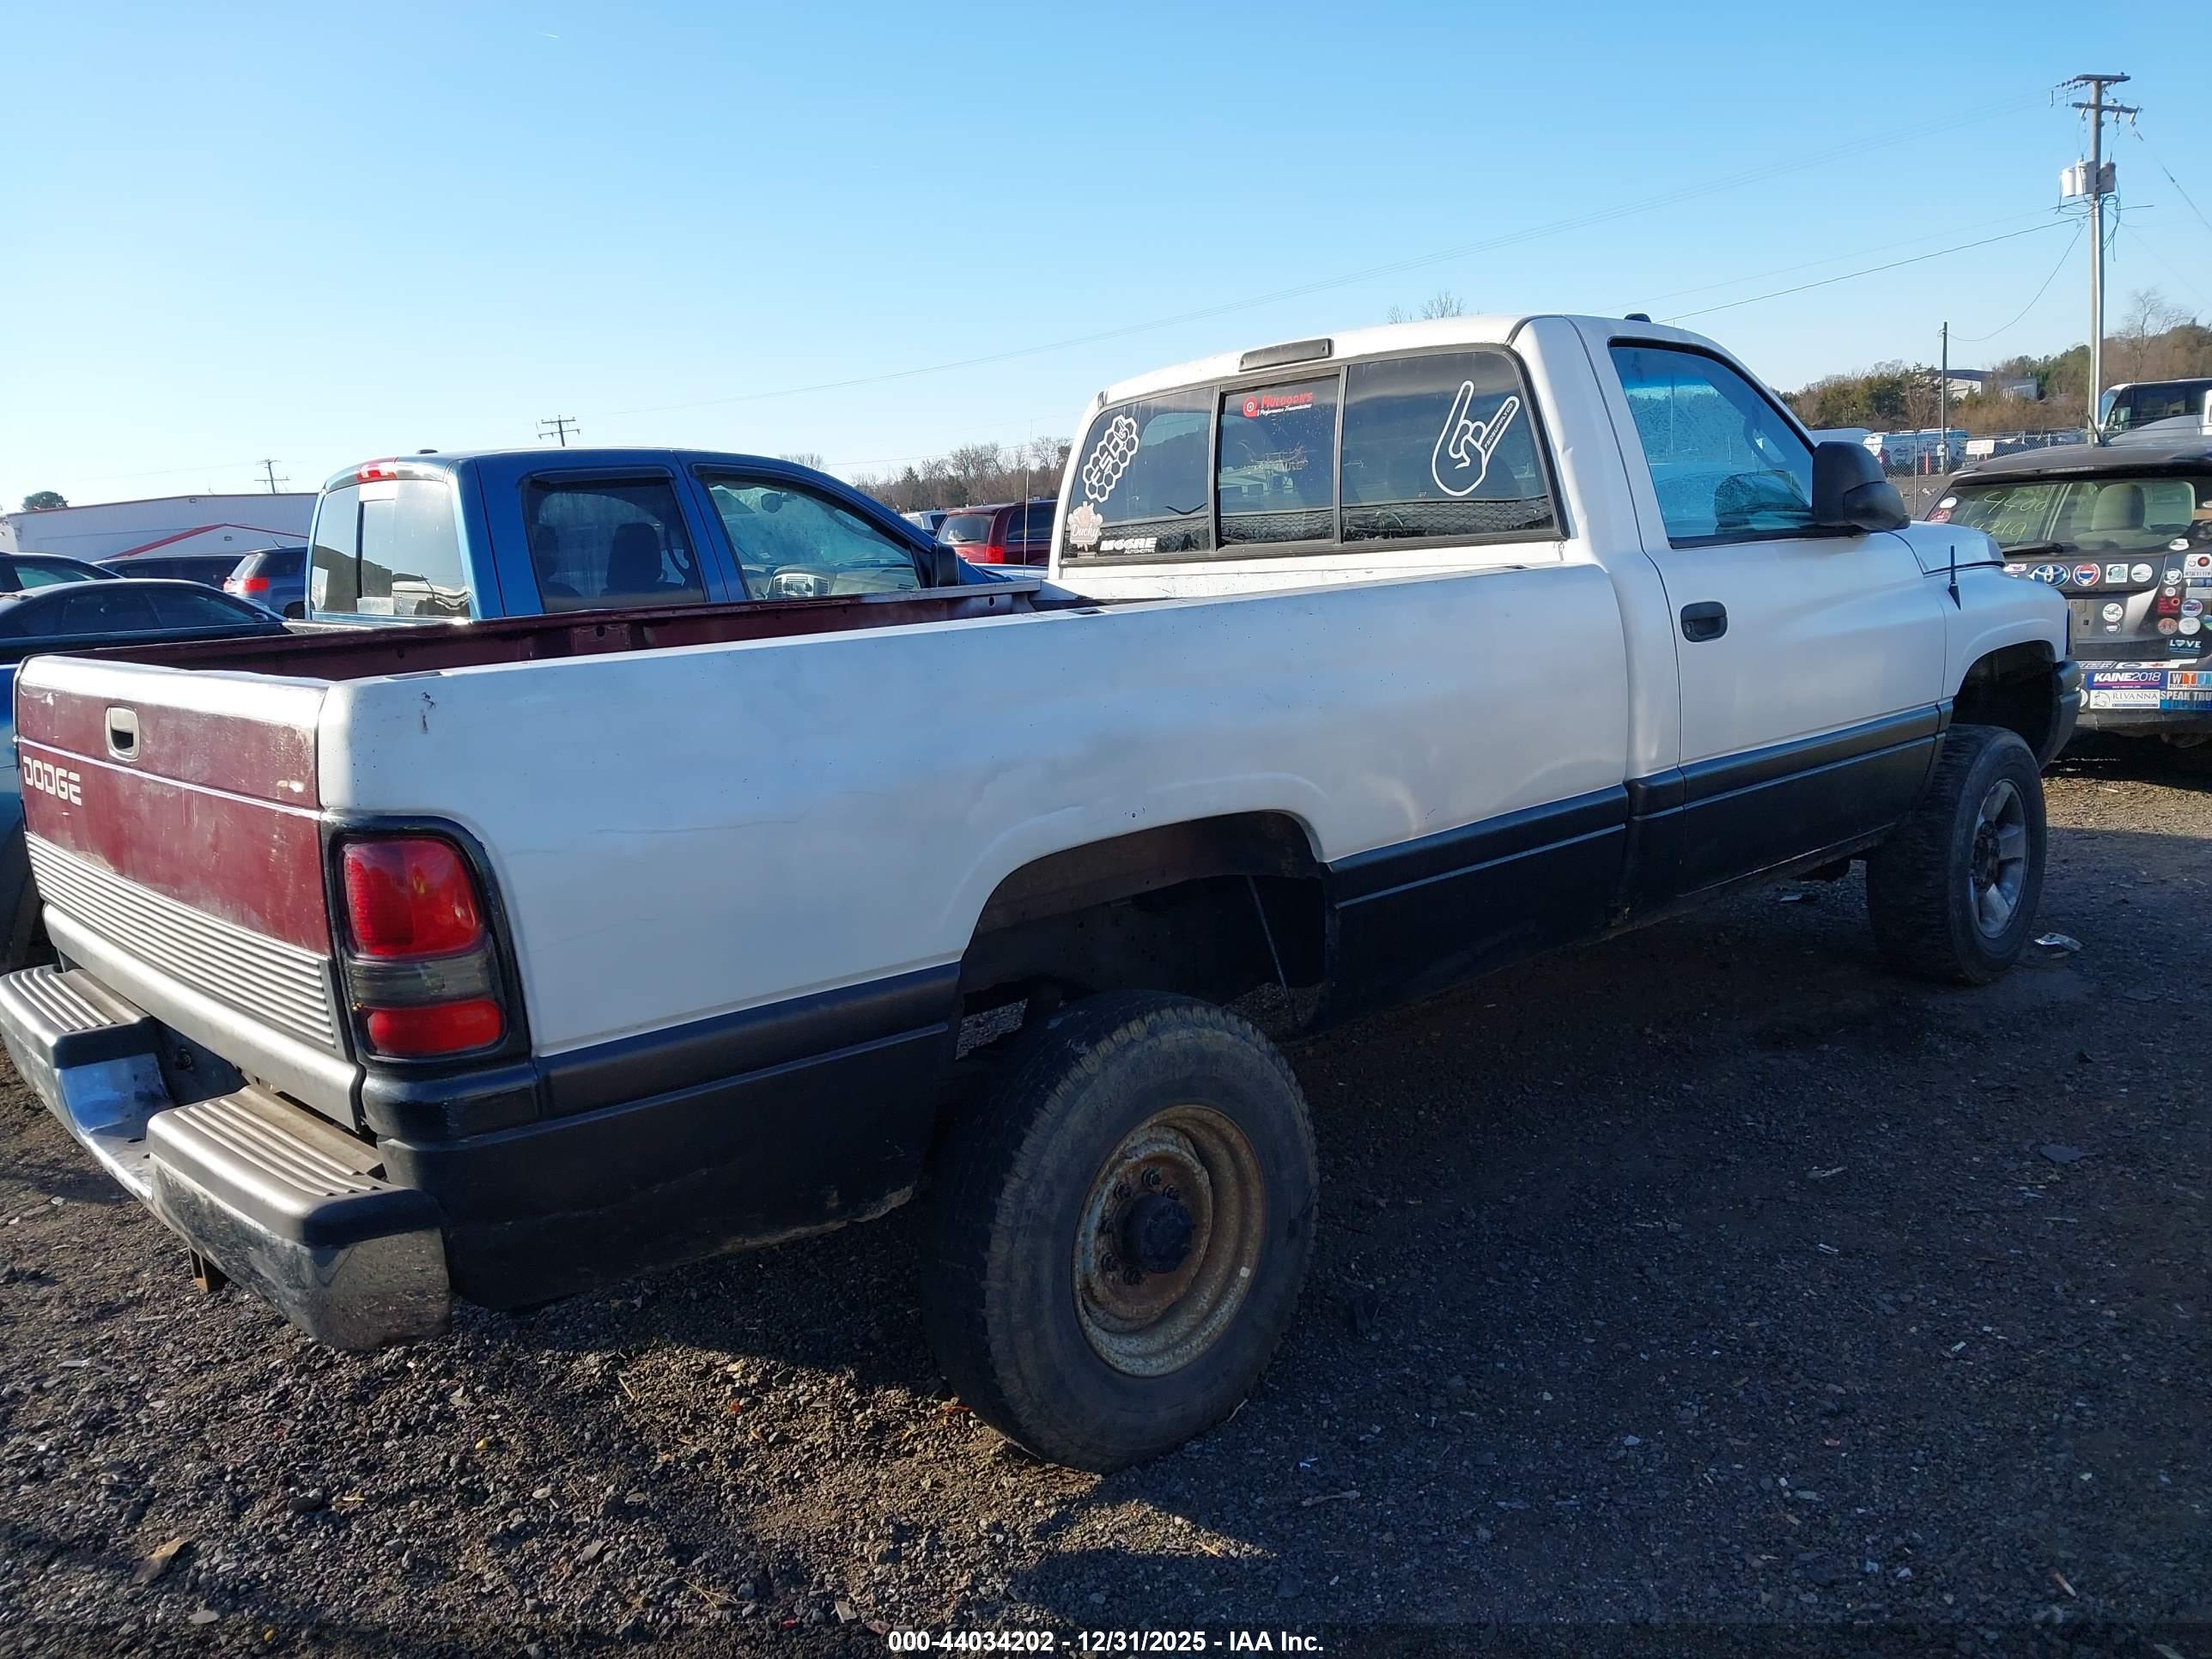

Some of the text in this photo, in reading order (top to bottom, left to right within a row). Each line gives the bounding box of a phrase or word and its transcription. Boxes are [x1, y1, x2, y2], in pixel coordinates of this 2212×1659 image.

[1100, 537, 1158, 551] MOORE
[2112, 691, 2158, 701] RIVANNA
[2160, 690, 2191, 701] SPEAK
[22, 755, 82, 806] DODGE
